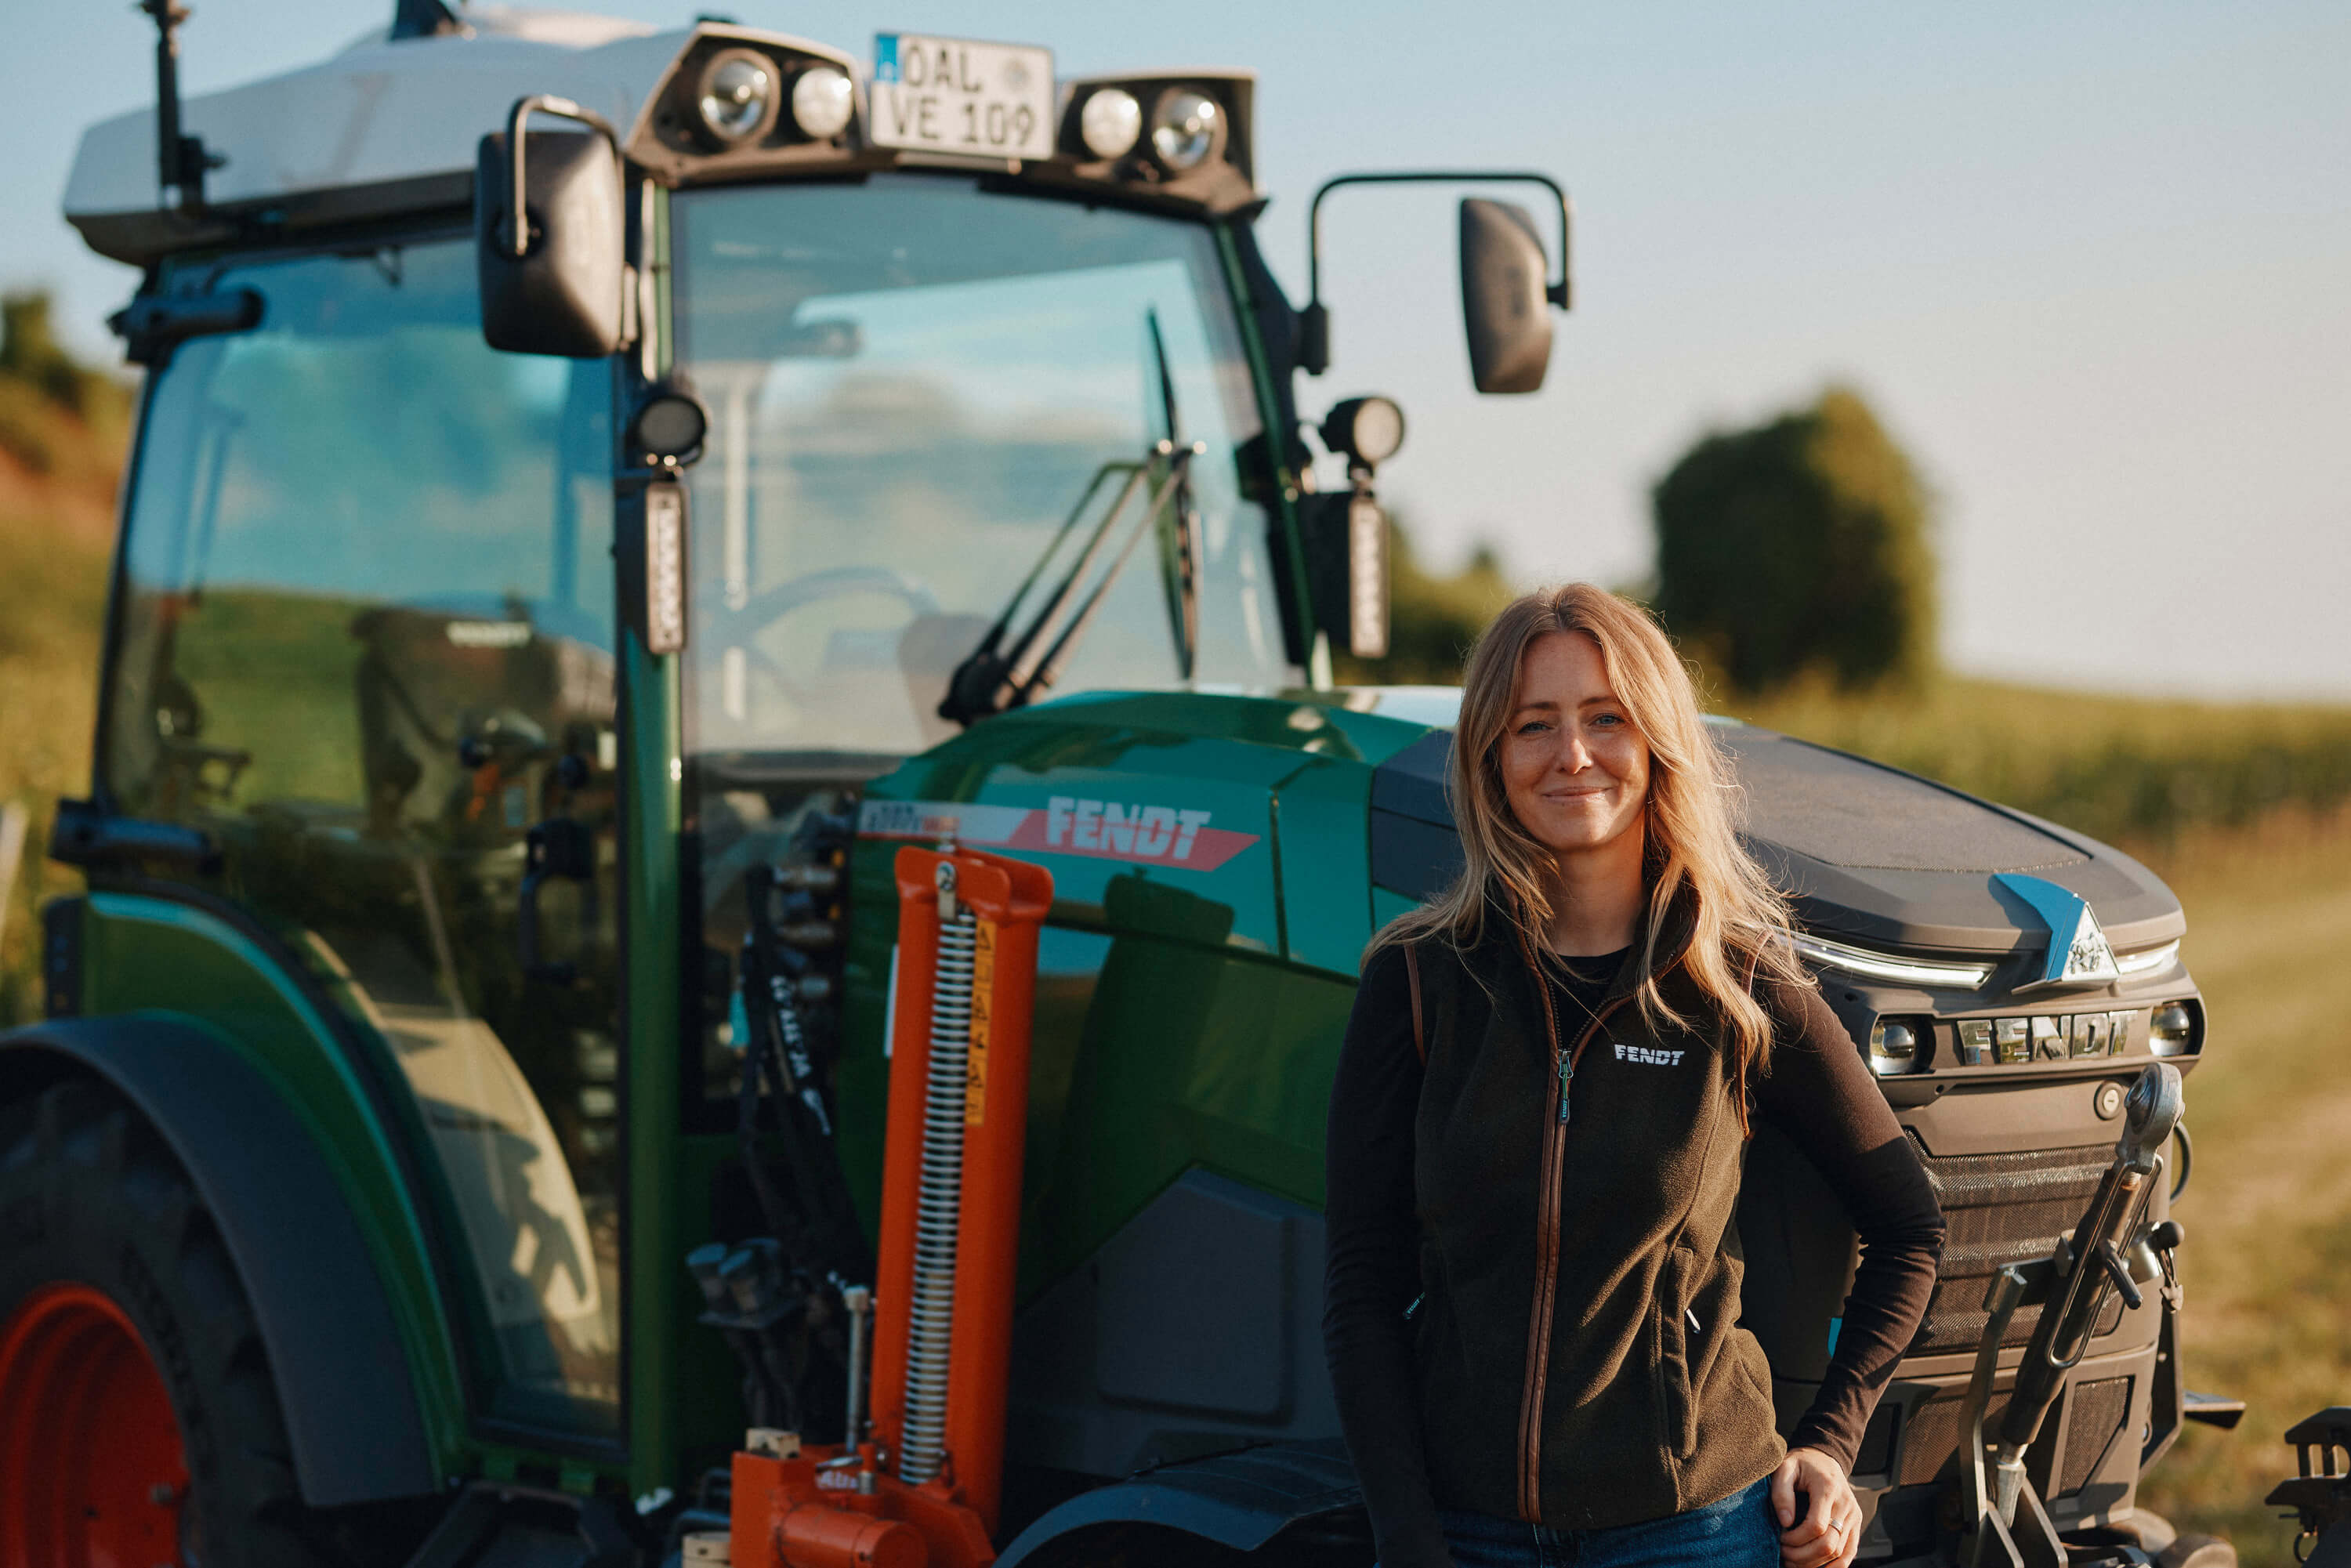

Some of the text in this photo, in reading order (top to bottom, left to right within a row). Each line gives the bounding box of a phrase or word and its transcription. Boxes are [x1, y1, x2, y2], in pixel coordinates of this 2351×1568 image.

[904, 45, 981, 92] OAL
[890, 92, 1036, 147] VE 109
[1046, 795, 1212, 860] FENDT
[1614, 1044, 1685, 1066] FENDT
[1957, 1009, 2139, 1065] FENDT
